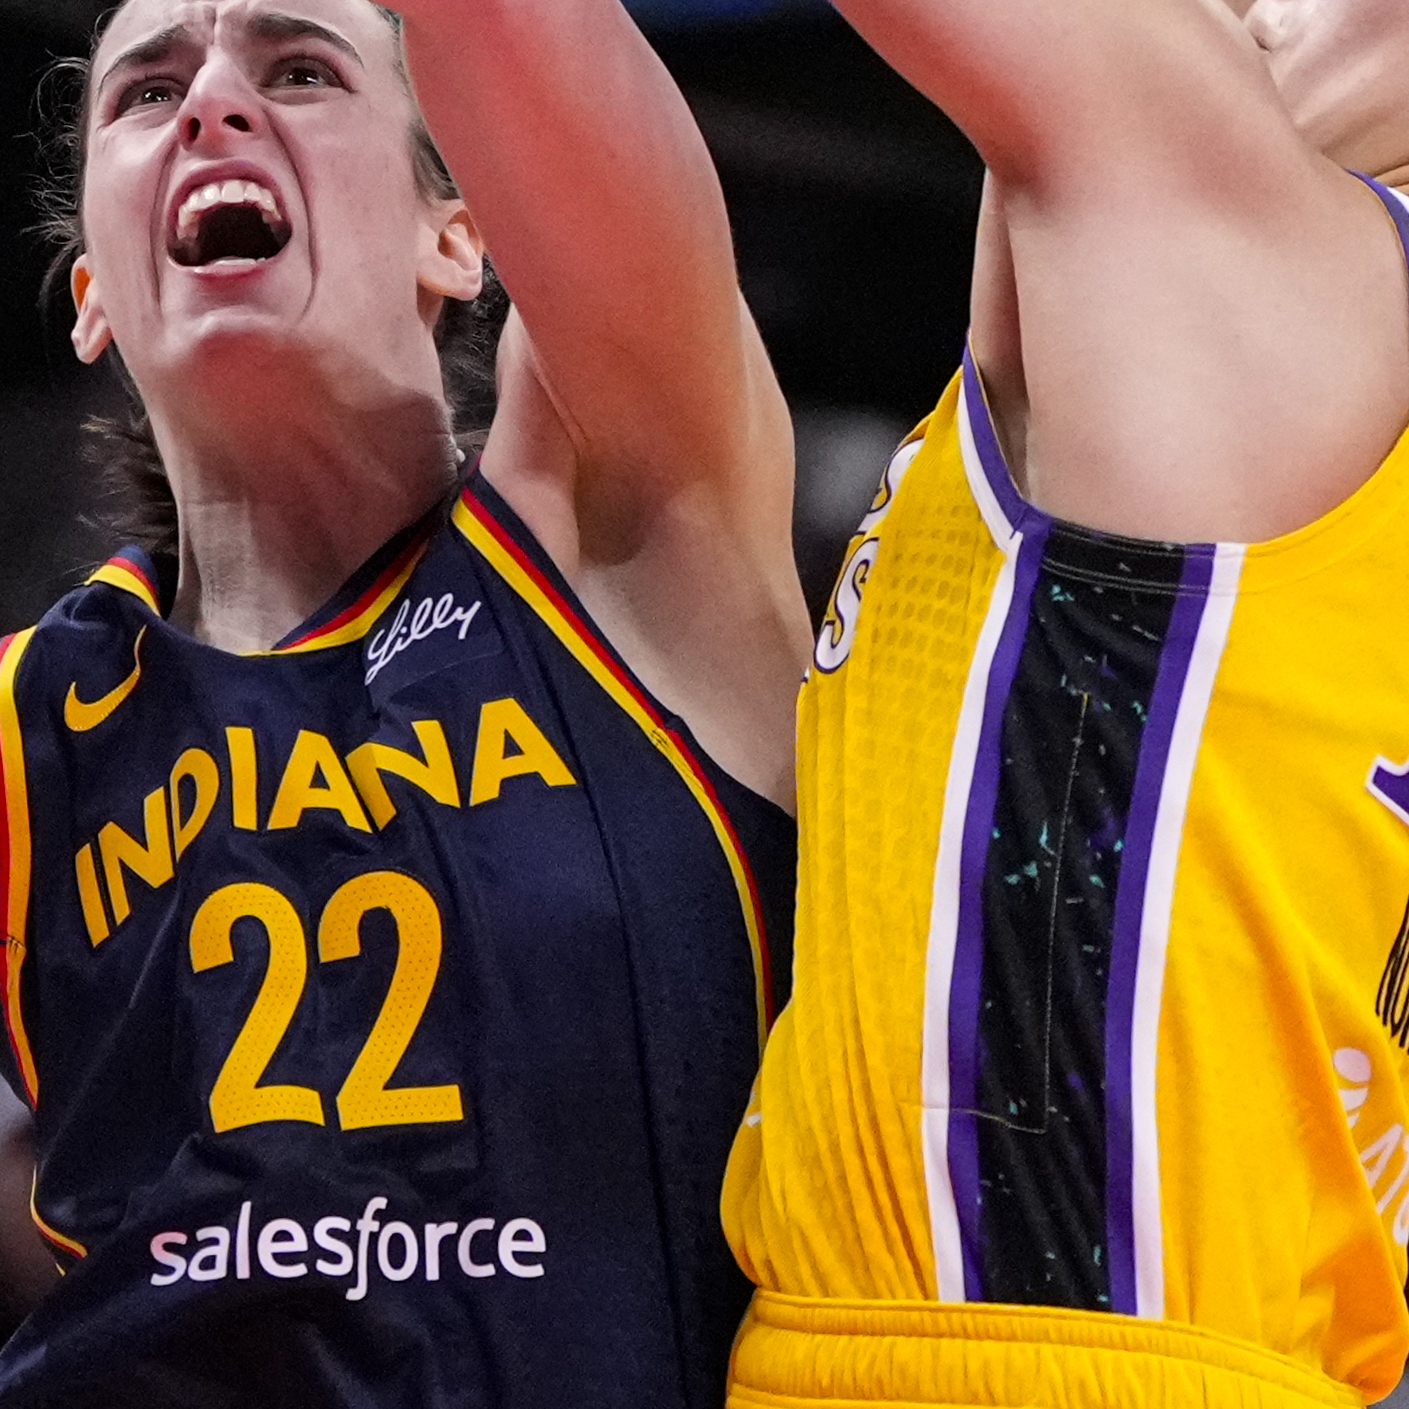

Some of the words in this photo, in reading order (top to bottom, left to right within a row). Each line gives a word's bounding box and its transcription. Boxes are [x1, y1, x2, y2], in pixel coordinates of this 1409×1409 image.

[364, 592, 482, 686] Lilly
[74, 696, 576, 949] INDIANA
[189, 870, 464, 1134] 22
[149, 1196, 546, 1301] salesforce
